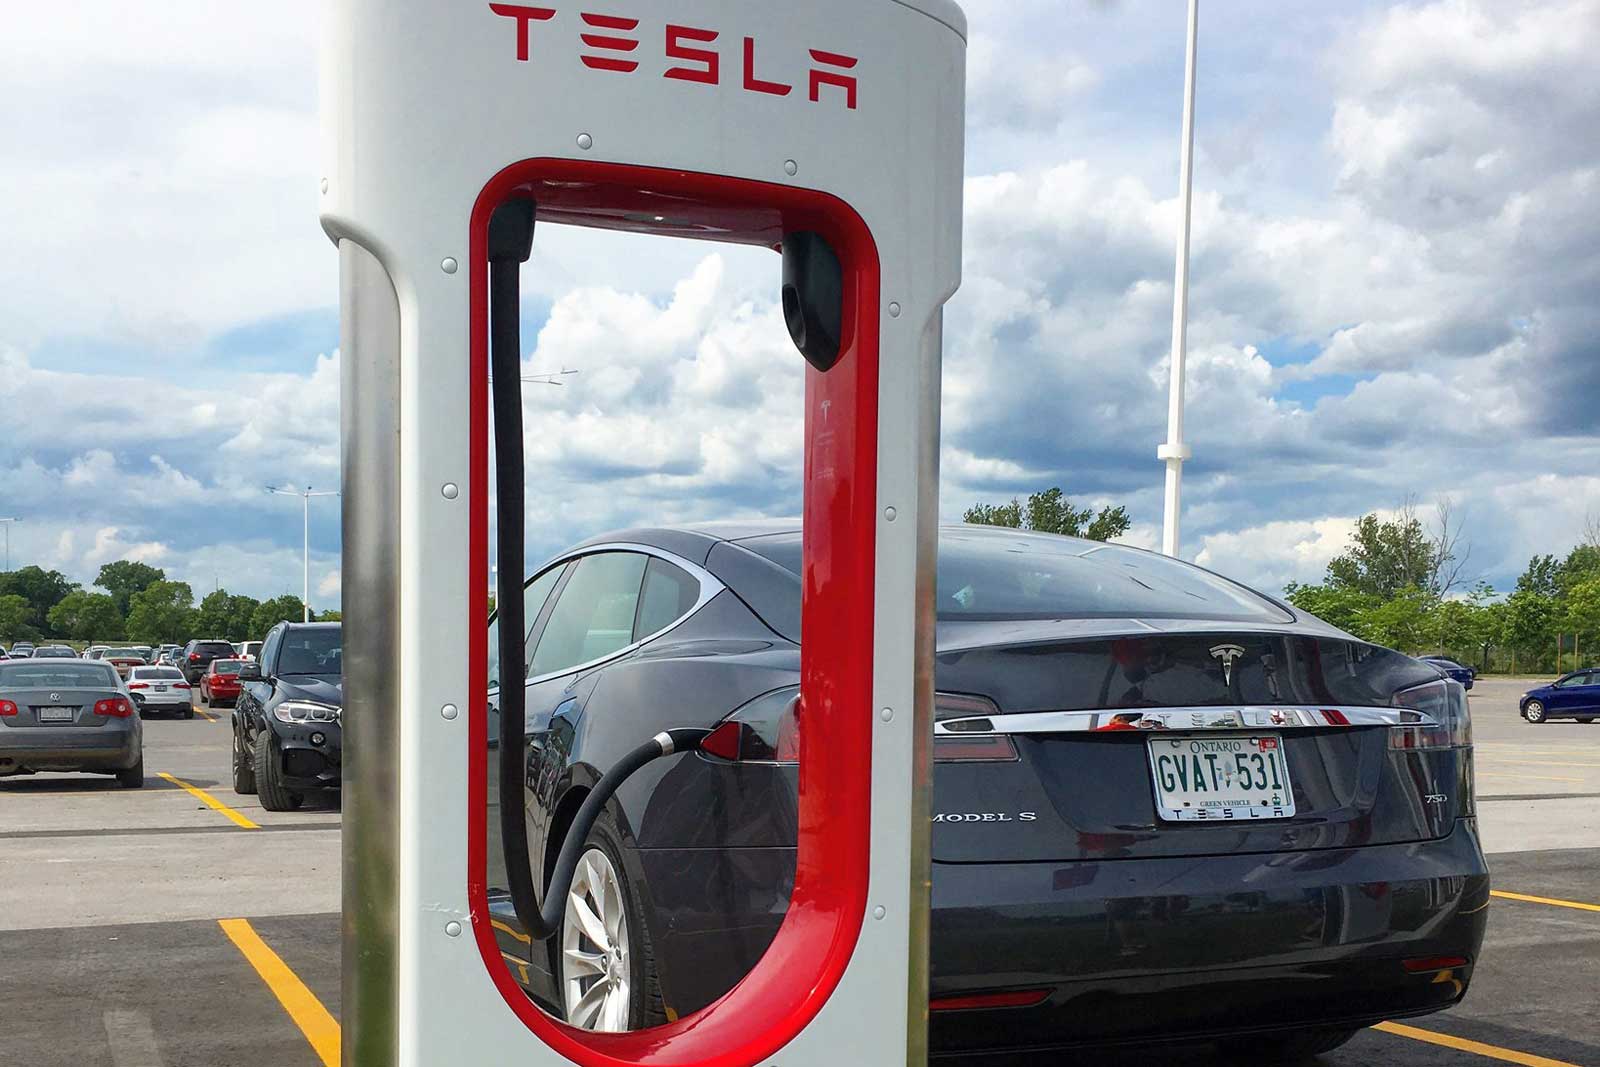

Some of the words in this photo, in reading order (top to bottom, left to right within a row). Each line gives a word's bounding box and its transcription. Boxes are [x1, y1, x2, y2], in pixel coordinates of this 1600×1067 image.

[488, 2, 858, 109] TESLA
[1190, 741, 1241, 753] ONTARIO
[1158, 754, 1219, 792] GVAT
[1235, 753, 1282, 791] 531
[1019, 811, 1037, 821] S
[1173, 807, 1283, 820] TESLA
